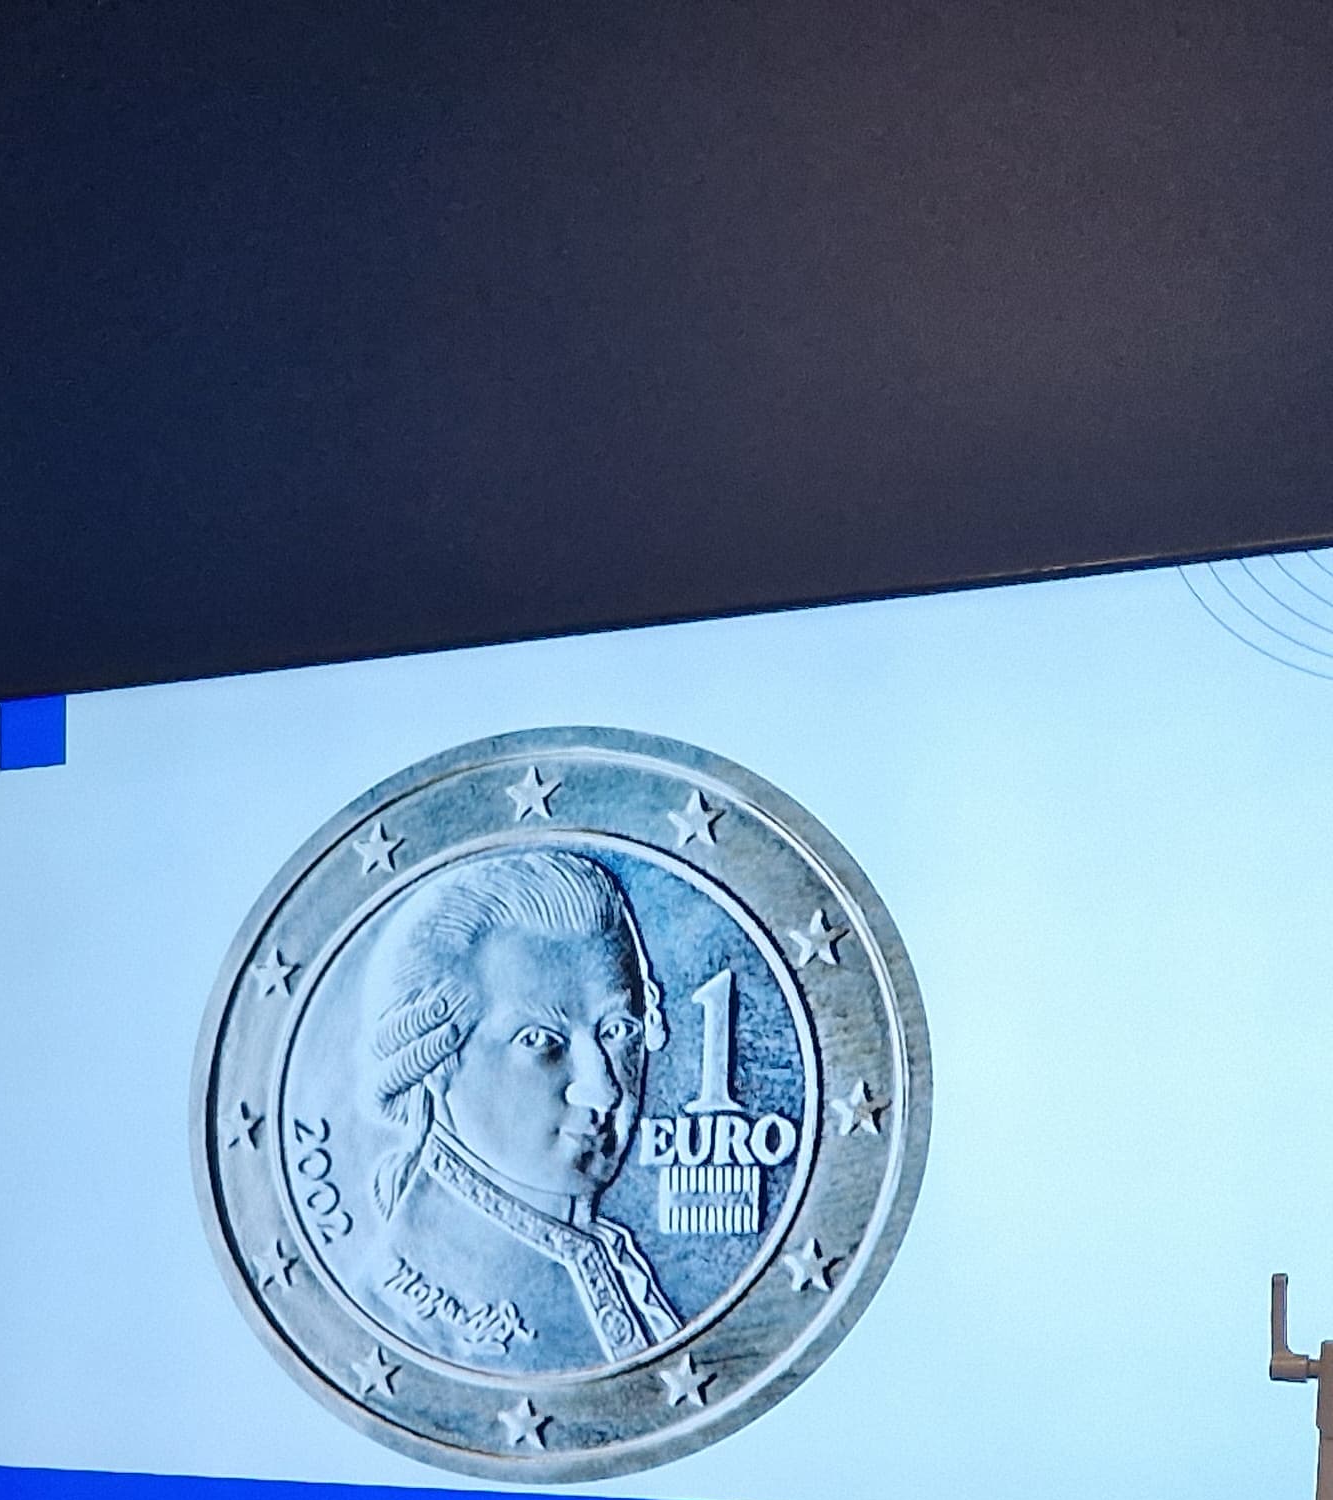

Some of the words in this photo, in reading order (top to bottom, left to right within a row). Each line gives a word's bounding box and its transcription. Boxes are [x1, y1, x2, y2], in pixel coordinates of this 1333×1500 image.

[683, 967, 746, 1115] 1
[293, 1116, 354, 1246] 2002
[639, 1113, 797, 1167] EURO
